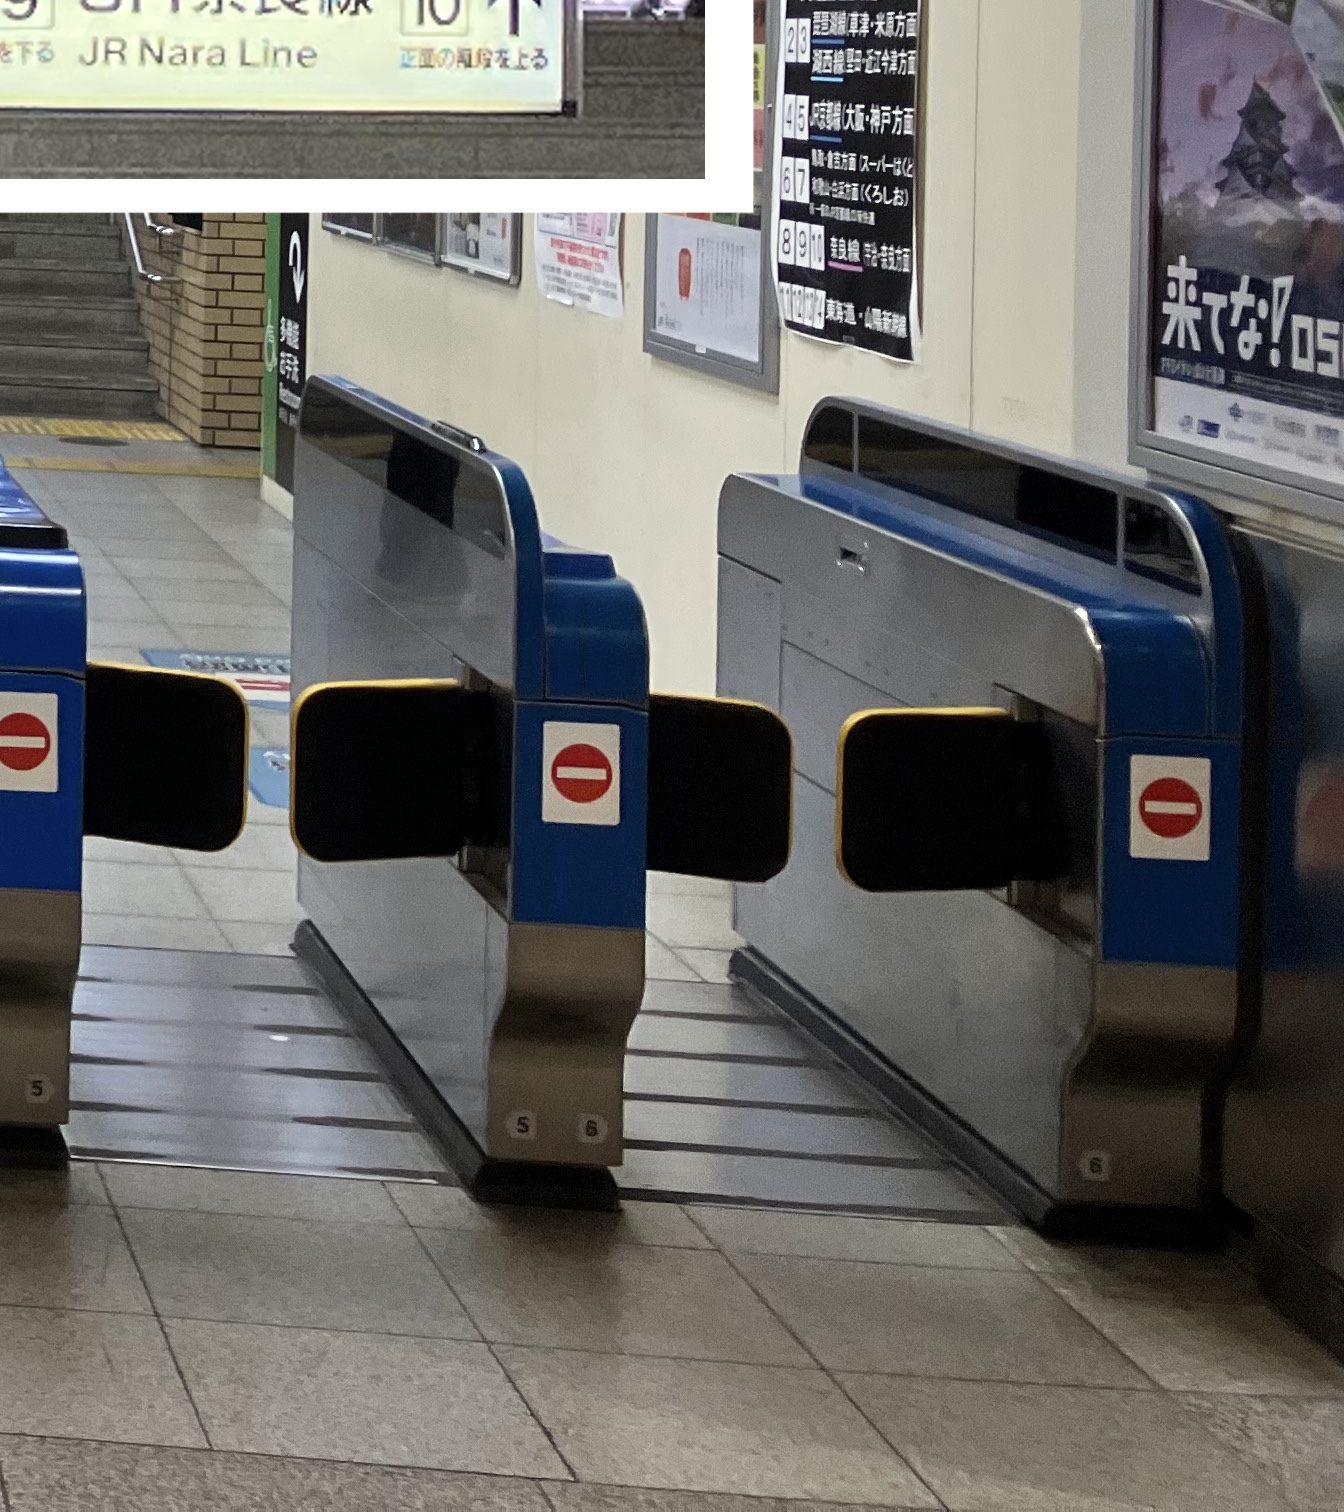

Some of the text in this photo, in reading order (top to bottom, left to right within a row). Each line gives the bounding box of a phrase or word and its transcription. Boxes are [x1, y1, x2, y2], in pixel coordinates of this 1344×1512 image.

[796, 167, 806, 196] 7
[782, 227, 791, 256] 8
[798, 229, 808, 258] 9
[1291, 314, 1344, 379] OS
[31, 1079, 44, 1096] 5
[516, 1116, 530, 1134] 5
